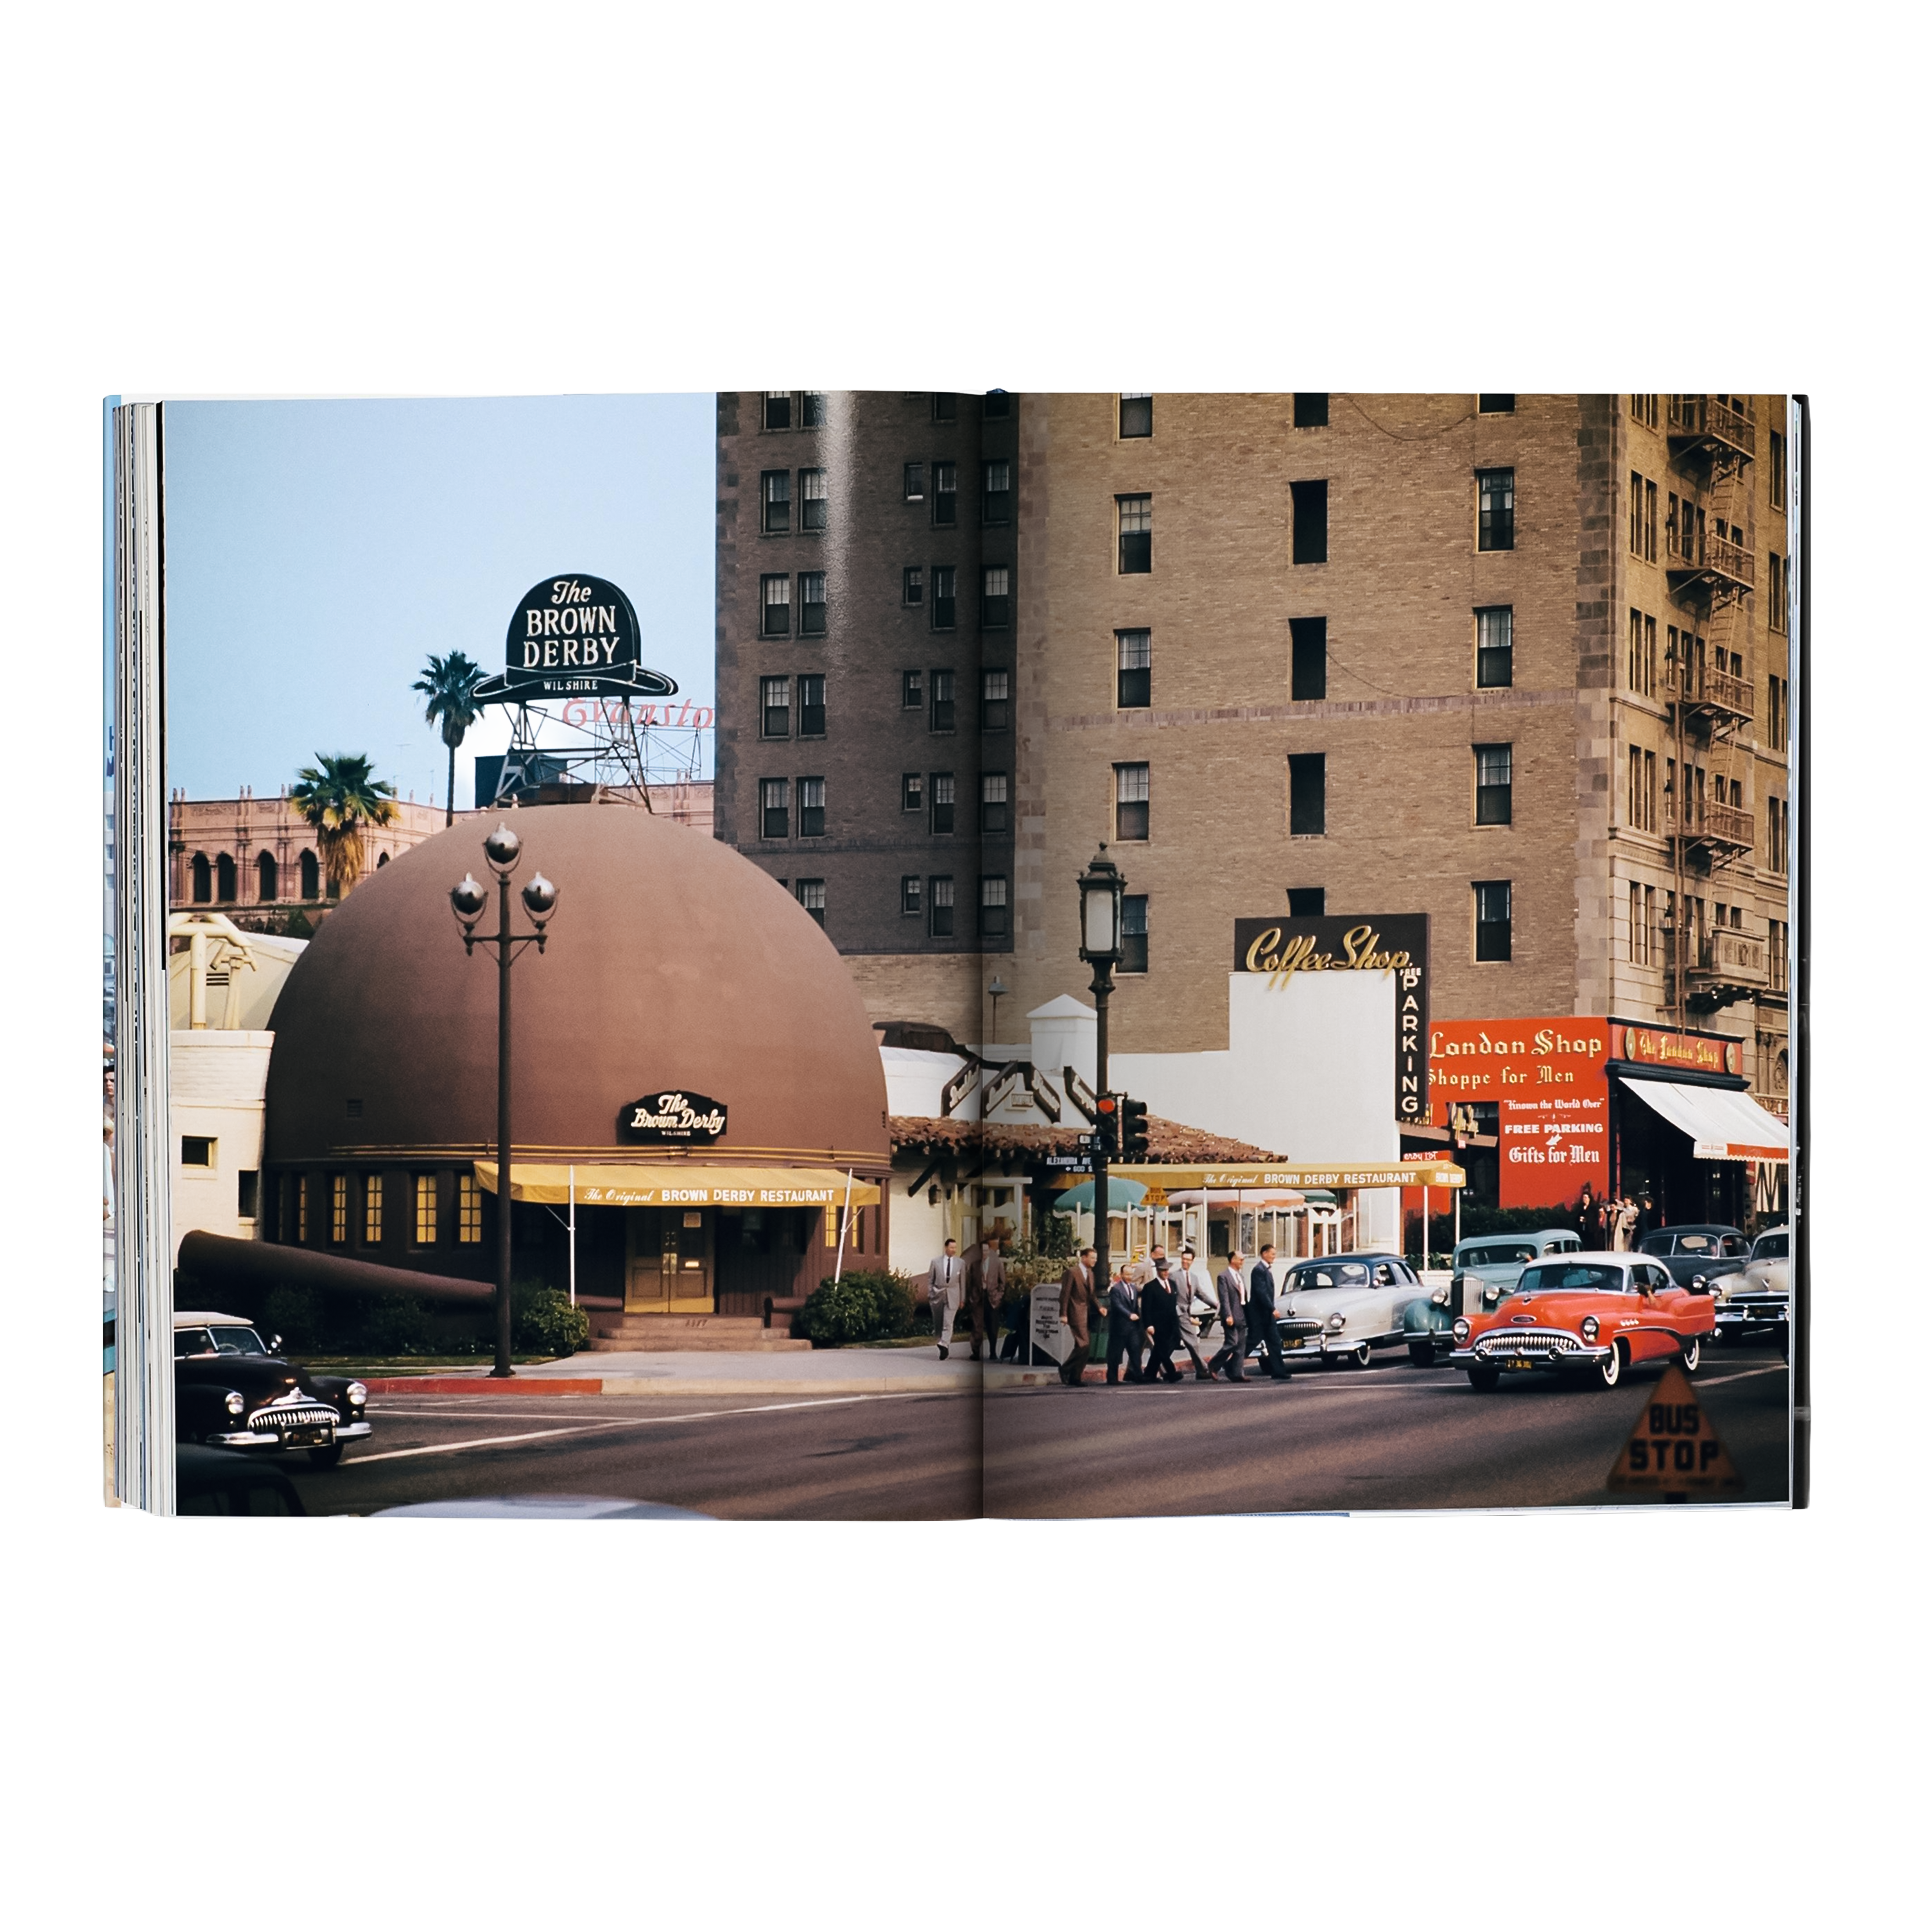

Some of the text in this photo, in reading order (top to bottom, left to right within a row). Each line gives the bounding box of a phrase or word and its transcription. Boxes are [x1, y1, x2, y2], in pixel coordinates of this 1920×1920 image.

[551, 580, 592, 604] The
[526, 605, 616, 637] BROWN
[523, 636, 620, 668] DERBY
[543, 679, 598, 691] WILSHIRE
[1246, 924, 1413, 991] Coffee Shop
[1401, 974, 1419, 1114] PARKING
[1429, 1028, 1602, 1059] London Shop
[1500, 1066, 1528, 1084] for
[1536, 1065, 1574, 1084] Men
[658, 1093, 689, 1115] The
[1540, 1099, 1553, 1110] the
[1554, 1098, 1581, 1110] World
[630, 1107, 726, 1135] Brown Derby
[1504, 1123, 1604, 1134] FREE PARKING
[1508, 1144, 1600, 1166] Gifts for Men
[1202, 1173, 1217, 1184] The
[1264, 1173, 1300, 1184] BROWN
[1304, 1173, 1340, 1185] DERBY
[1344, 1172, 1417, 1184] RESTAURANT
[584, 1188, 834, 1206] The Original BROWN DERBY RESTAURANT
[1649, 1402, 1700, 1435] BUS
[1628, 1438, 1721, 1472] STOP
